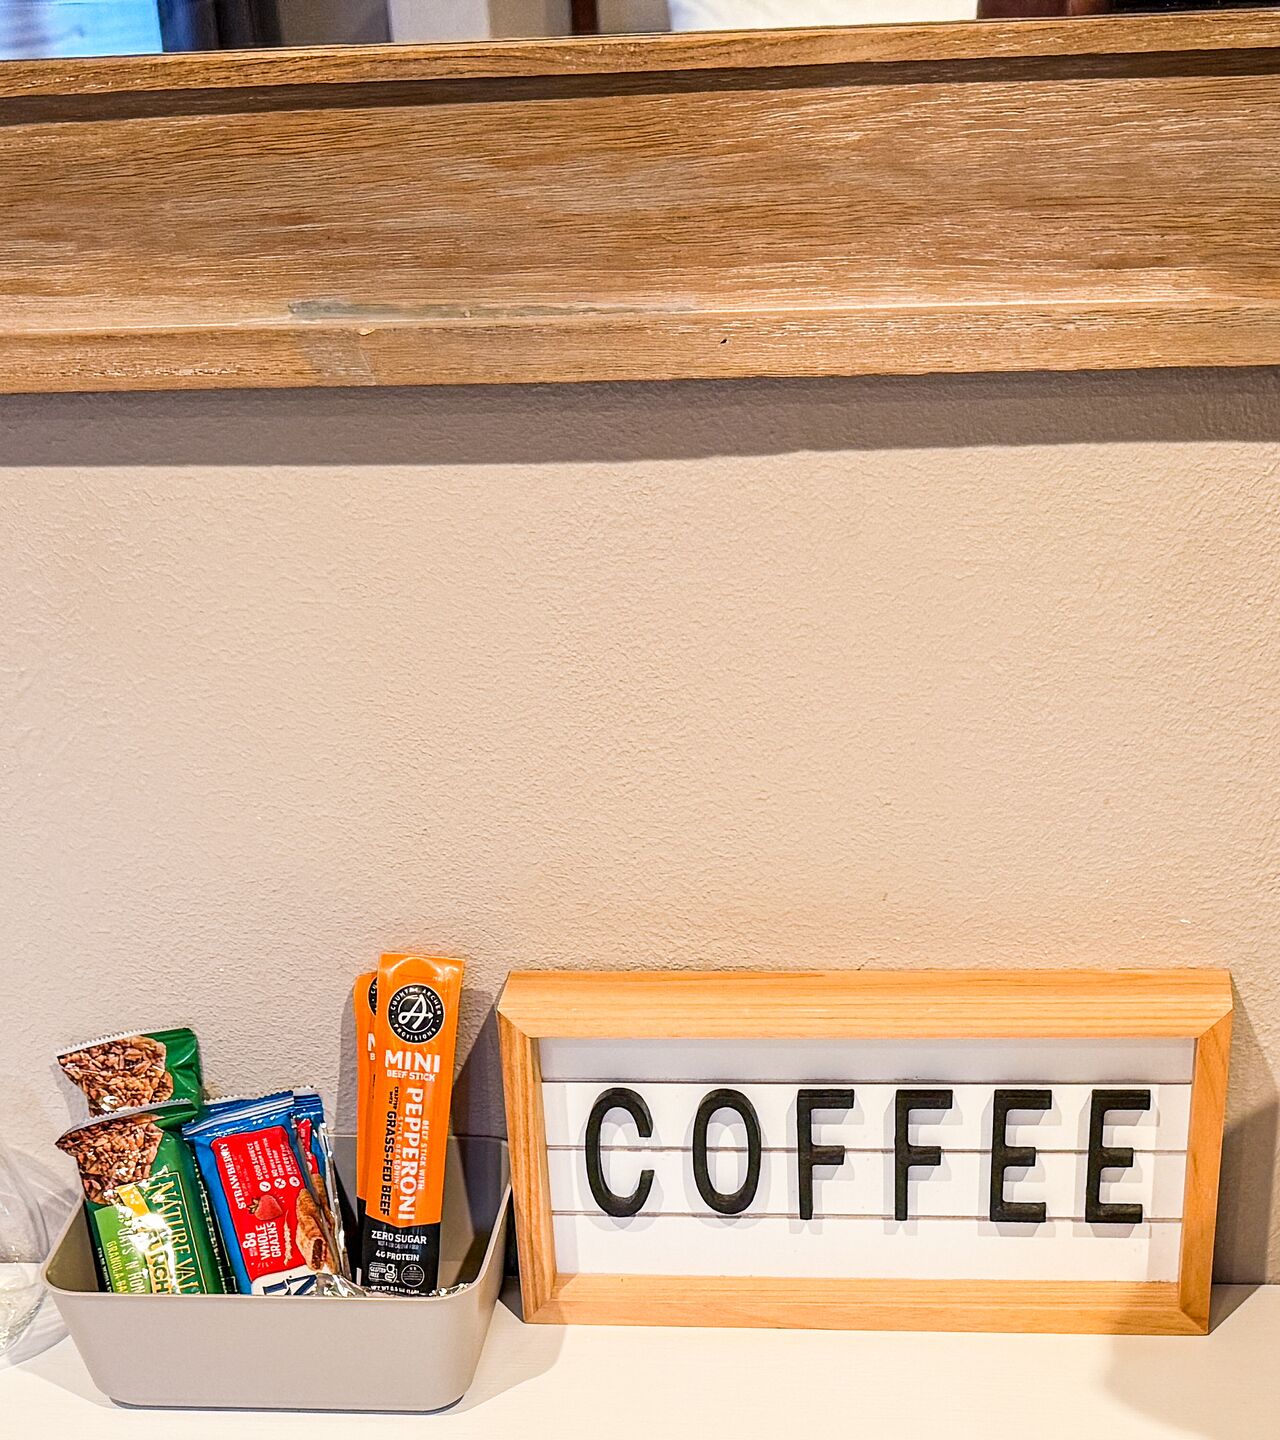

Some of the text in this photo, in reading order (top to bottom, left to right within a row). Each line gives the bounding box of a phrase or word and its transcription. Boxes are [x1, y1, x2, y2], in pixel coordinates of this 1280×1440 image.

[385, 1049, 440, 1073] MINI
[386, 1069, 435, 1082] BEEF STICK
[380, 1111, 397, 1216] GRASS-FED BEEF
[398, 1087, 423, 1220] PEPPERONI
[585, 1087, 1152, 1224] COFFEE
[218, 1143, 247, 1210] STRAWBERRY
[256, 1223, 270, 1261] WHOLE
[265, 1221, 282, 1258] GRAINS
[371, 1230, 427, 1244] ZERO SUGAR
[387, 1251, 419, 1261] PROTEIN
[106, 1240, 125, 1280] GRANOLA
